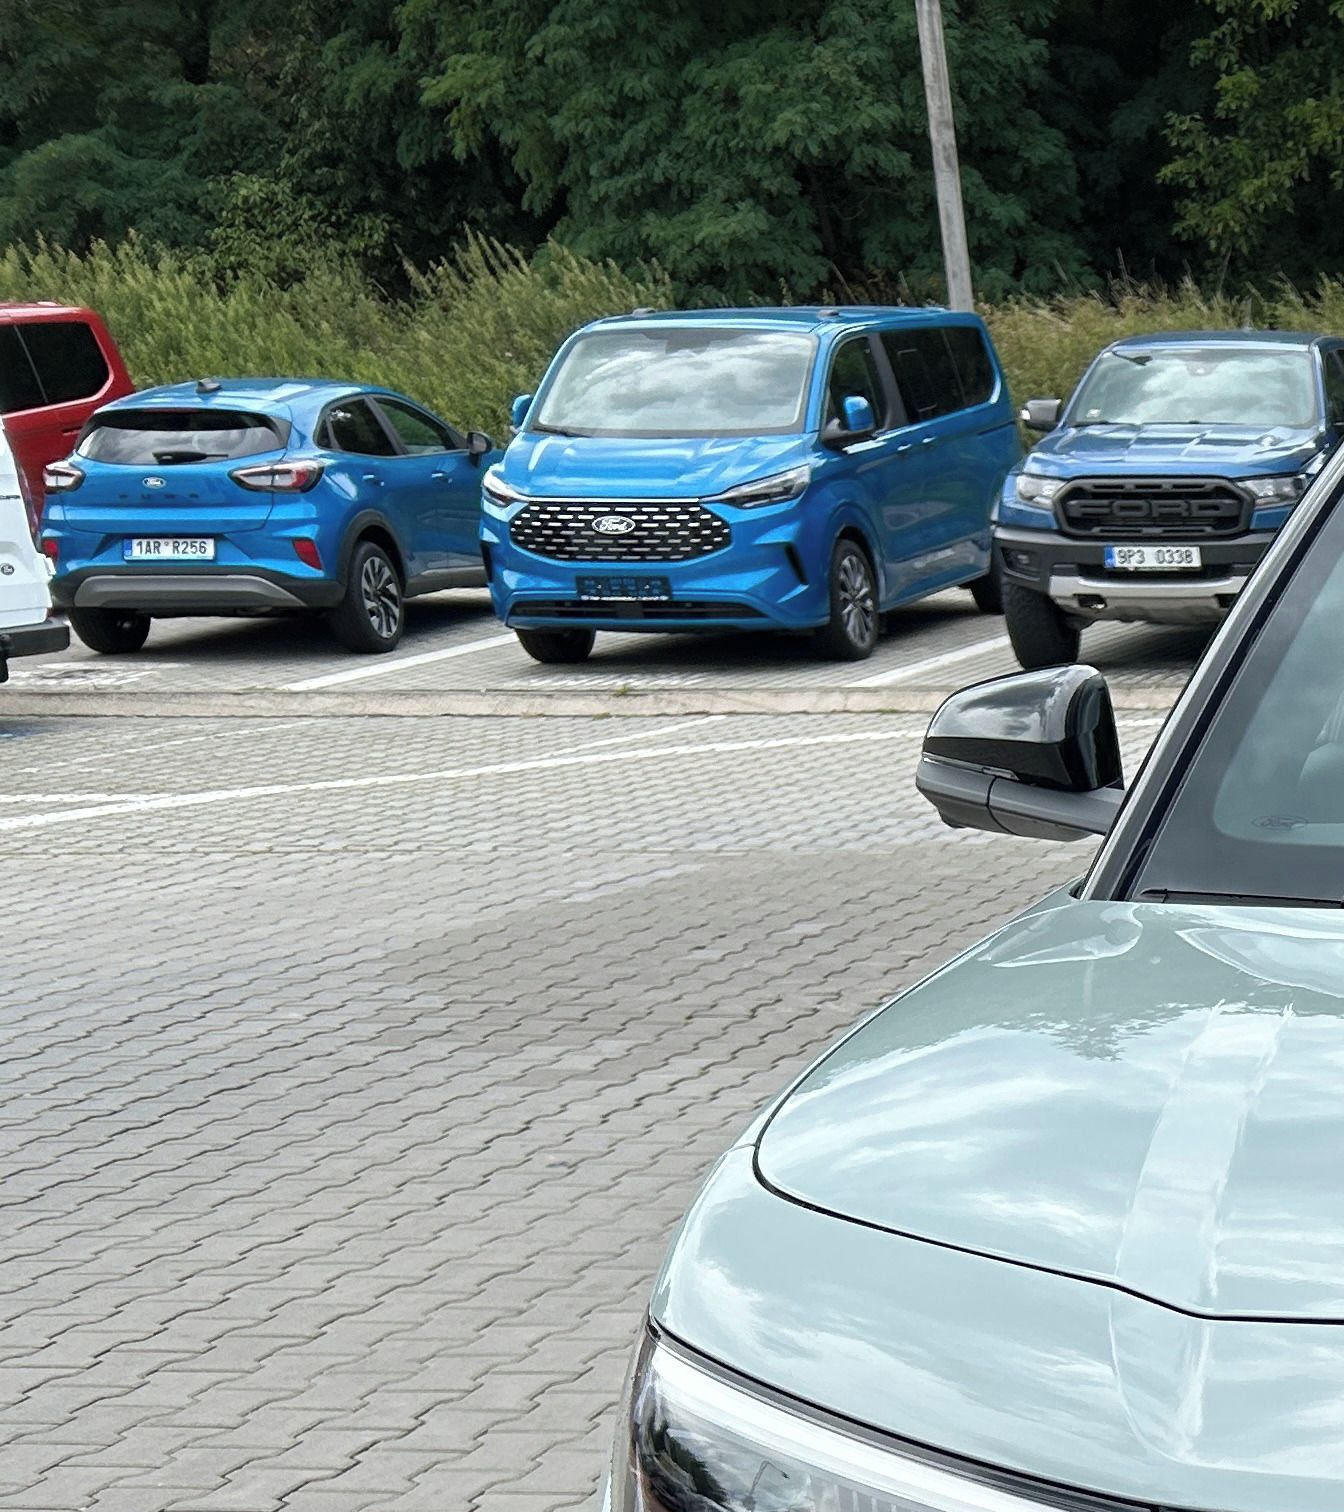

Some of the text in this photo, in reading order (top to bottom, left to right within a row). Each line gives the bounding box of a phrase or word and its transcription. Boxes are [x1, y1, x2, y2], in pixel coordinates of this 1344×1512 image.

[1066, 499, 1241, 517] FORD
[136, 541, 207, 554] 1AR R256
[1117, 549, 1145, 564] 9P3
